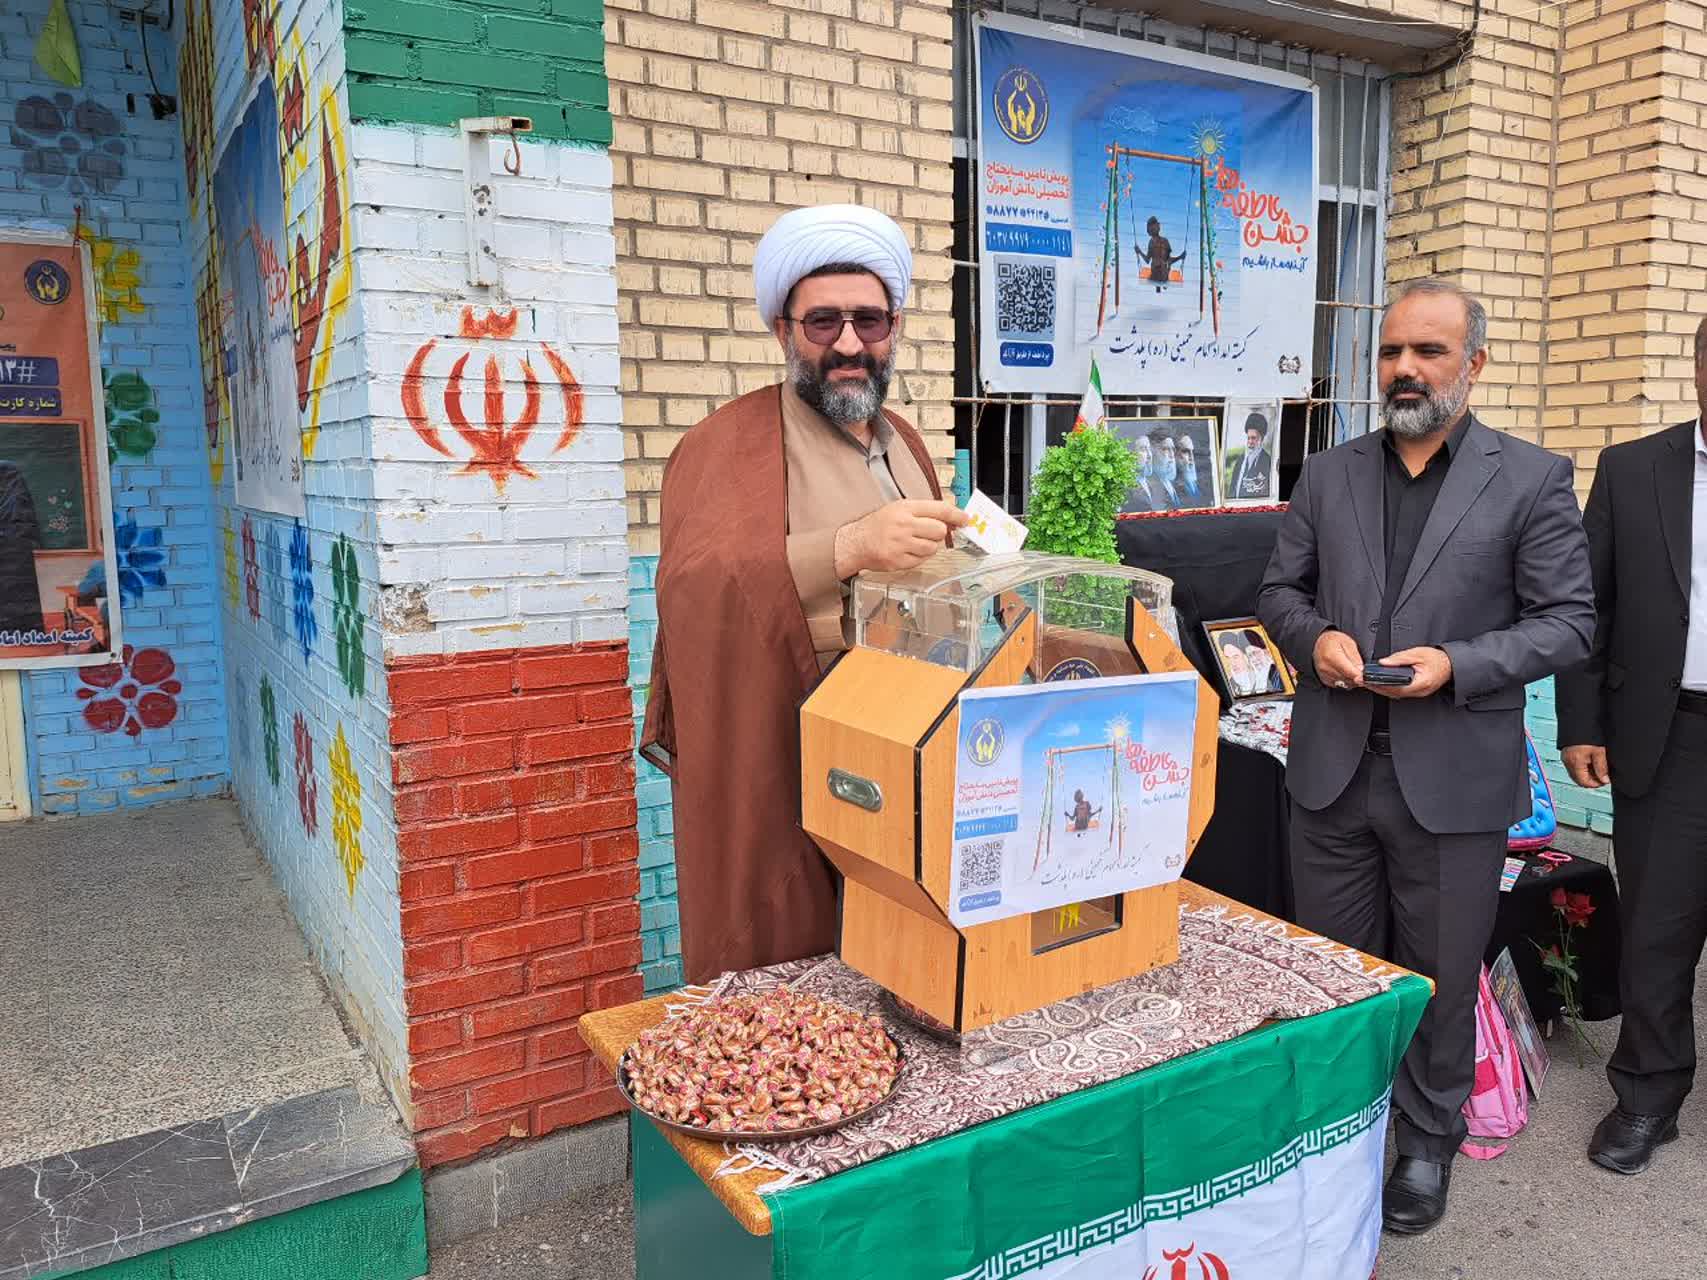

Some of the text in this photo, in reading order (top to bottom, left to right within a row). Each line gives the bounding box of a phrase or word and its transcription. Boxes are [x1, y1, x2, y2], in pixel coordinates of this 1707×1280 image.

[1244, 211, 1309, 253] جشن
[0, 627, 93, 646] کمیته امداد اما
